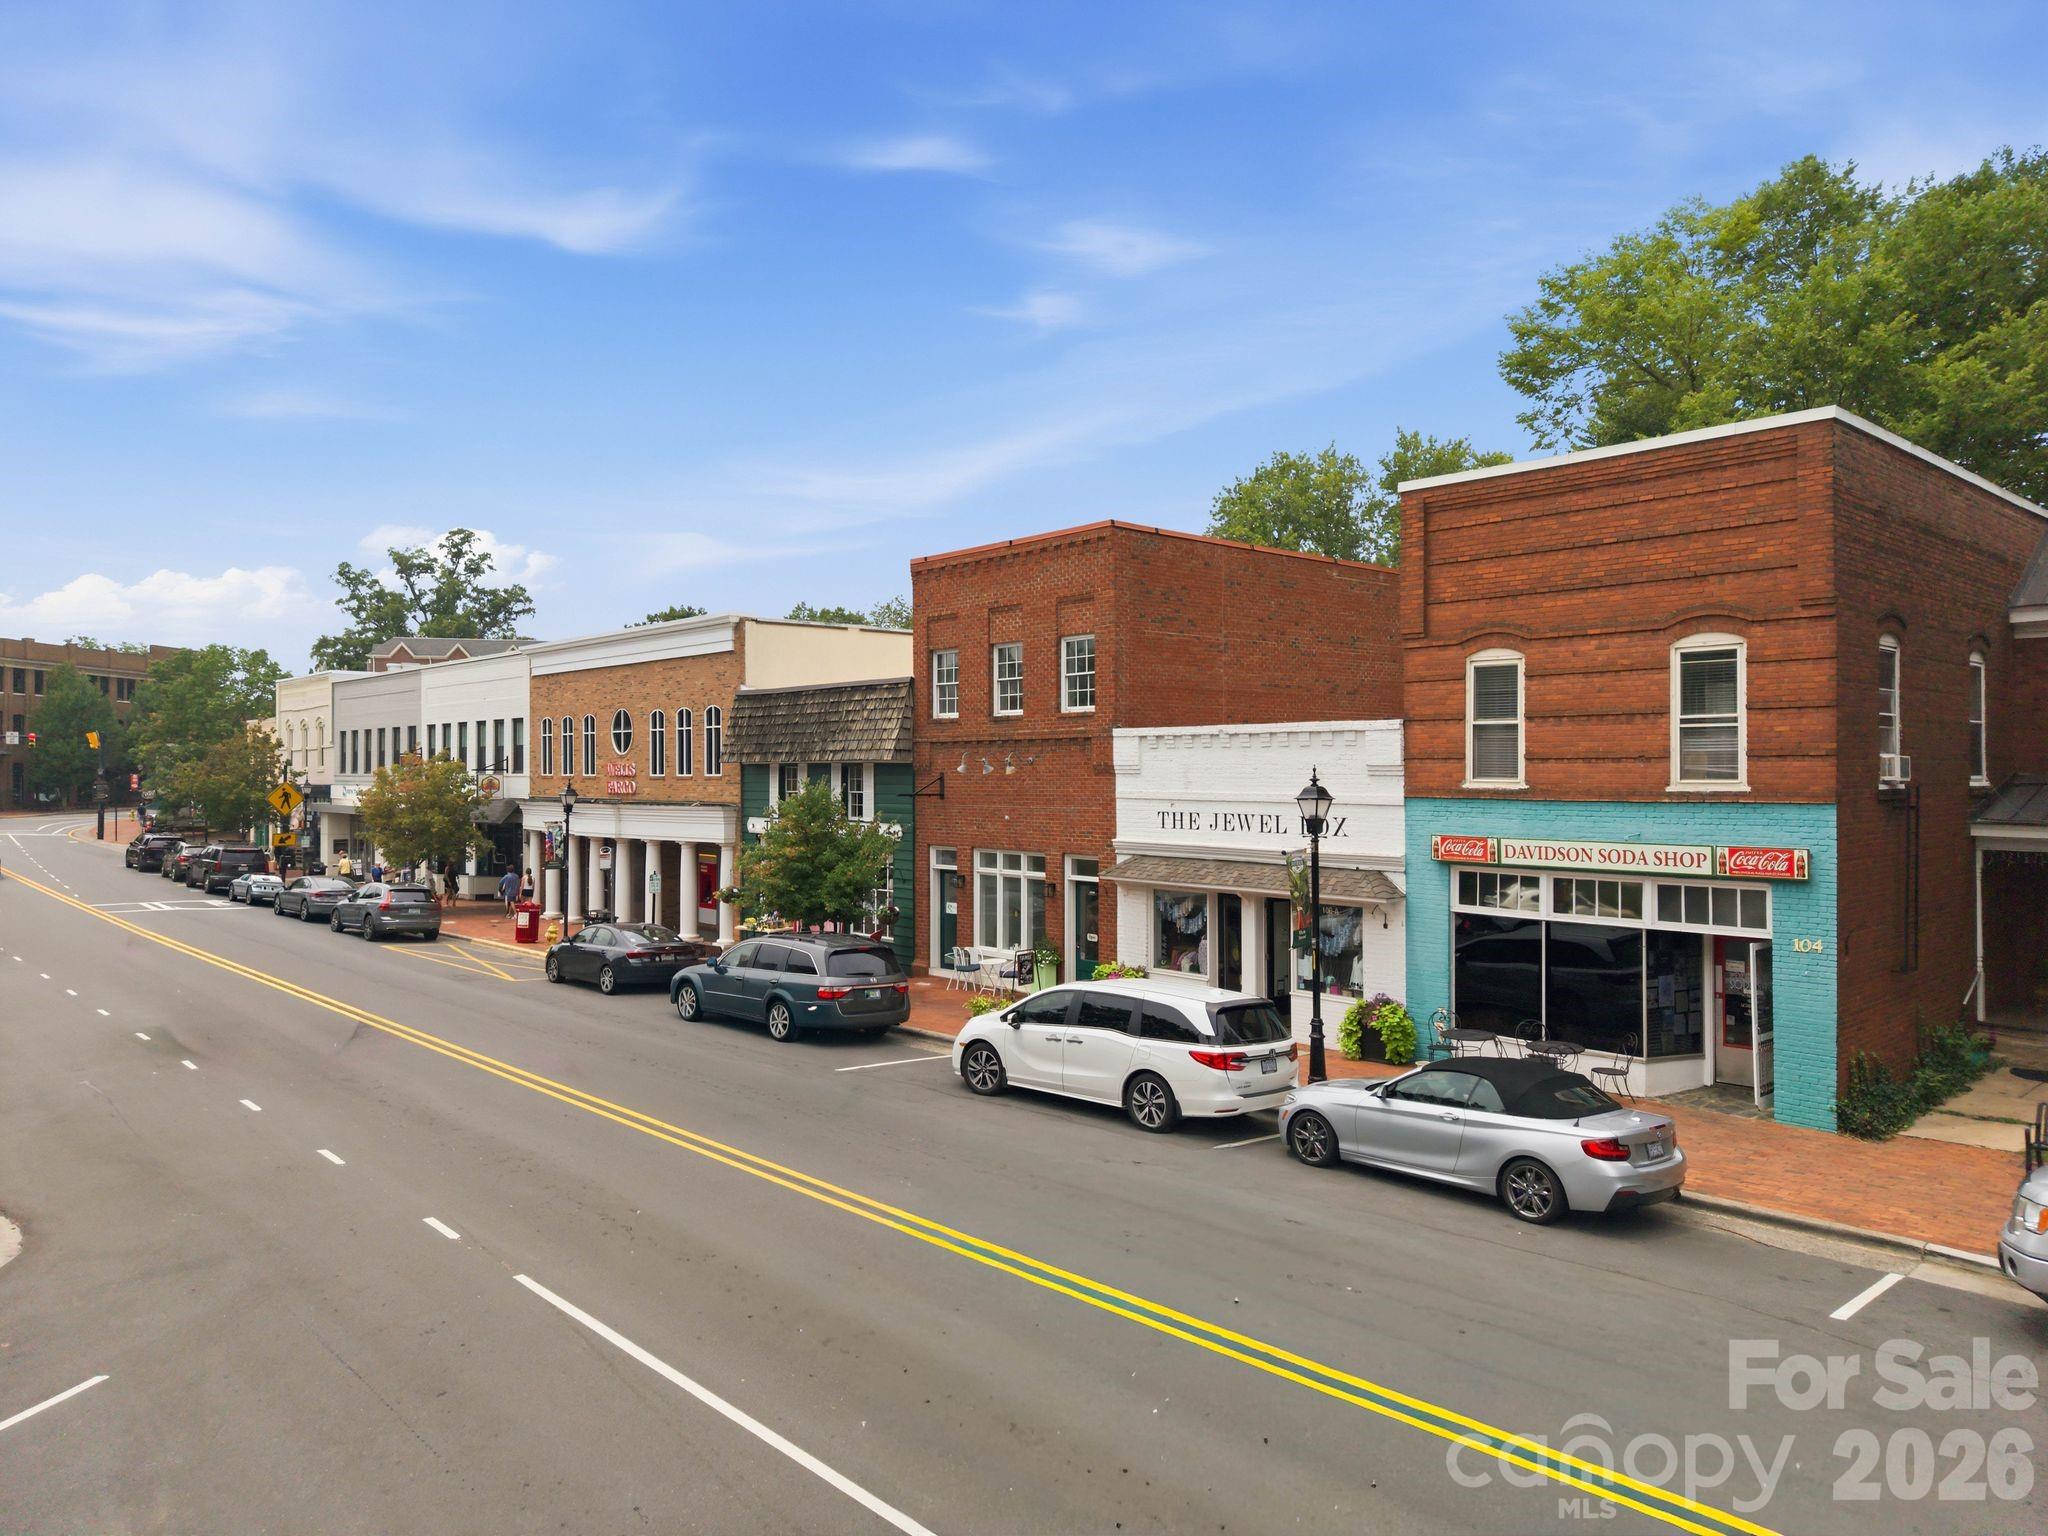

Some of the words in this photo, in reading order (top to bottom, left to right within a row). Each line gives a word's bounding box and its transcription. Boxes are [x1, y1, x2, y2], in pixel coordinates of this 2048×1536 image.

[607, 762, 637, 777] WELLS
[607, 780, 637, 794] FARGO
[1157, 811, 1200, 831] THE
[1209, 812, 1288, 834] JEWEL
[1441, 838, 1487, 856] Coca-Cola
[1504, 844, 1593, 863] DAVIDSON
[1598, 848, 1648, 867] SODA
[1653, 850, 1708, 868] SHOP
[1730, 850, 1792, 872] Coca-Cola
[1792, 938, 1823, 953] 104
